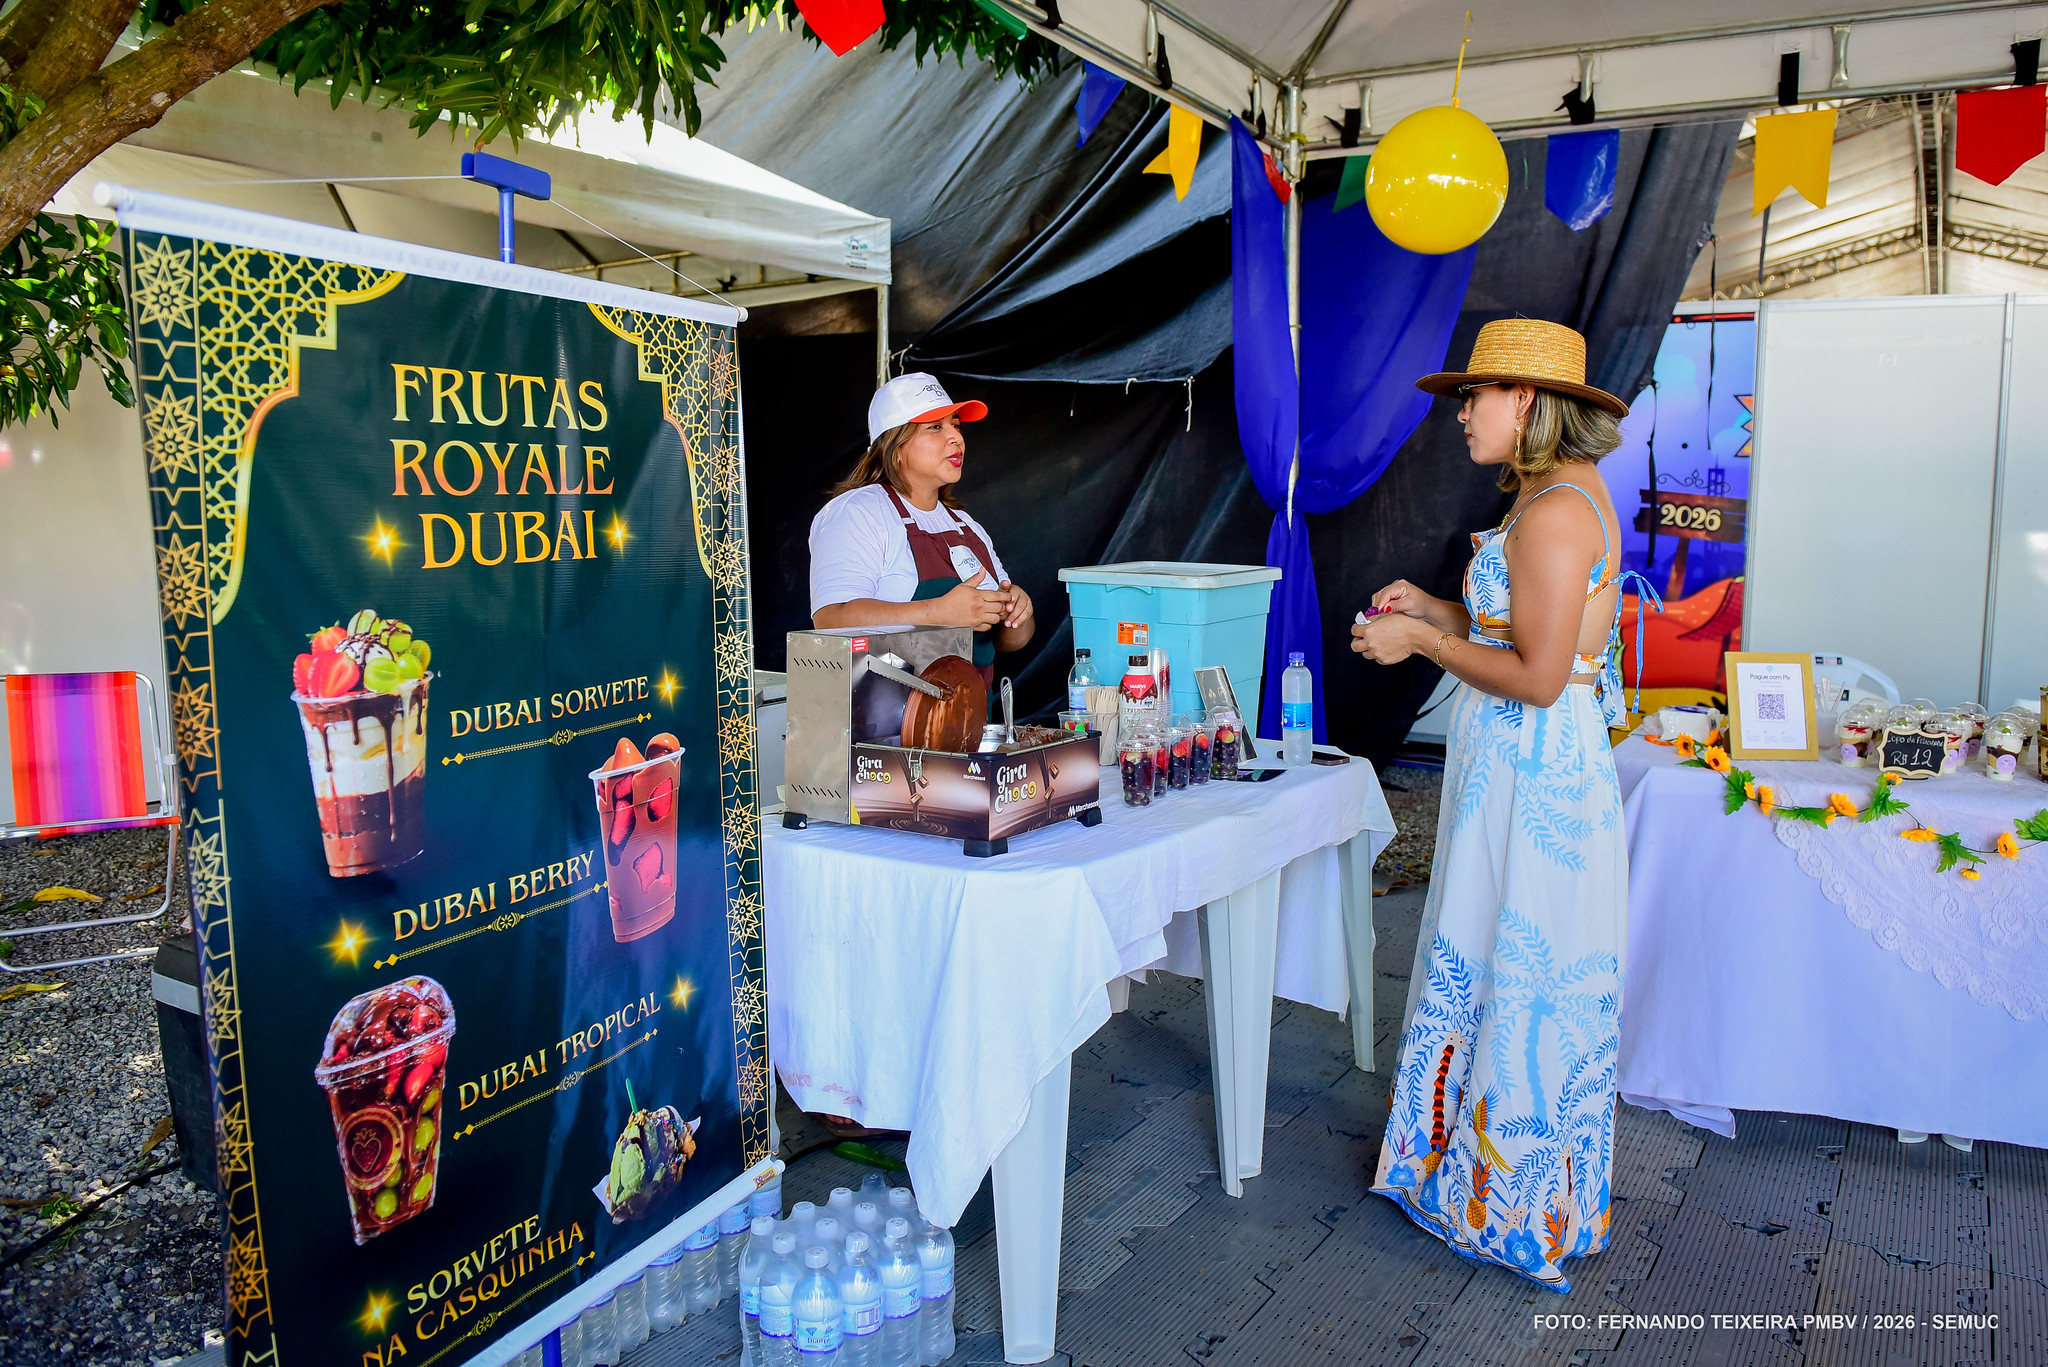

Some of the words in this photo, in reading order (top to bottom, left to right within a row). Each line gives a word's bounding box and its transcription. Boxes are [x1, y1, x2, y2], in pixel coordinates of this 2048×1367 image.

[390, 363, 608, 431] FRUTAS
[389, 439, 614, 496] ROYALE
[418, 510, 597, 569] DUBAI
[1660, 503, 1721, 531] 2026
[450, 697, 542, 737] DUBAI
[551, 676, 650, 718] SORVETE
[857, 756, 882, 772] Gira
[996, 763, 1027, 794] Gira
[1891, 751, 1908, 766] R$
[1910, 748, 1933, 767] 12
[392, 882, 497, 941] DUBAI
[508, 850, 594, 904] BERRY
[458, 1049, 548, 1111] DUBAI
[556, 992, 661, 1064] TROPICAL
[362, 1333, 407, 1367] NA
[416, 1221, 584, 1340] CASQUINHA
[407, 1214, 542, 1314] SORVETE
